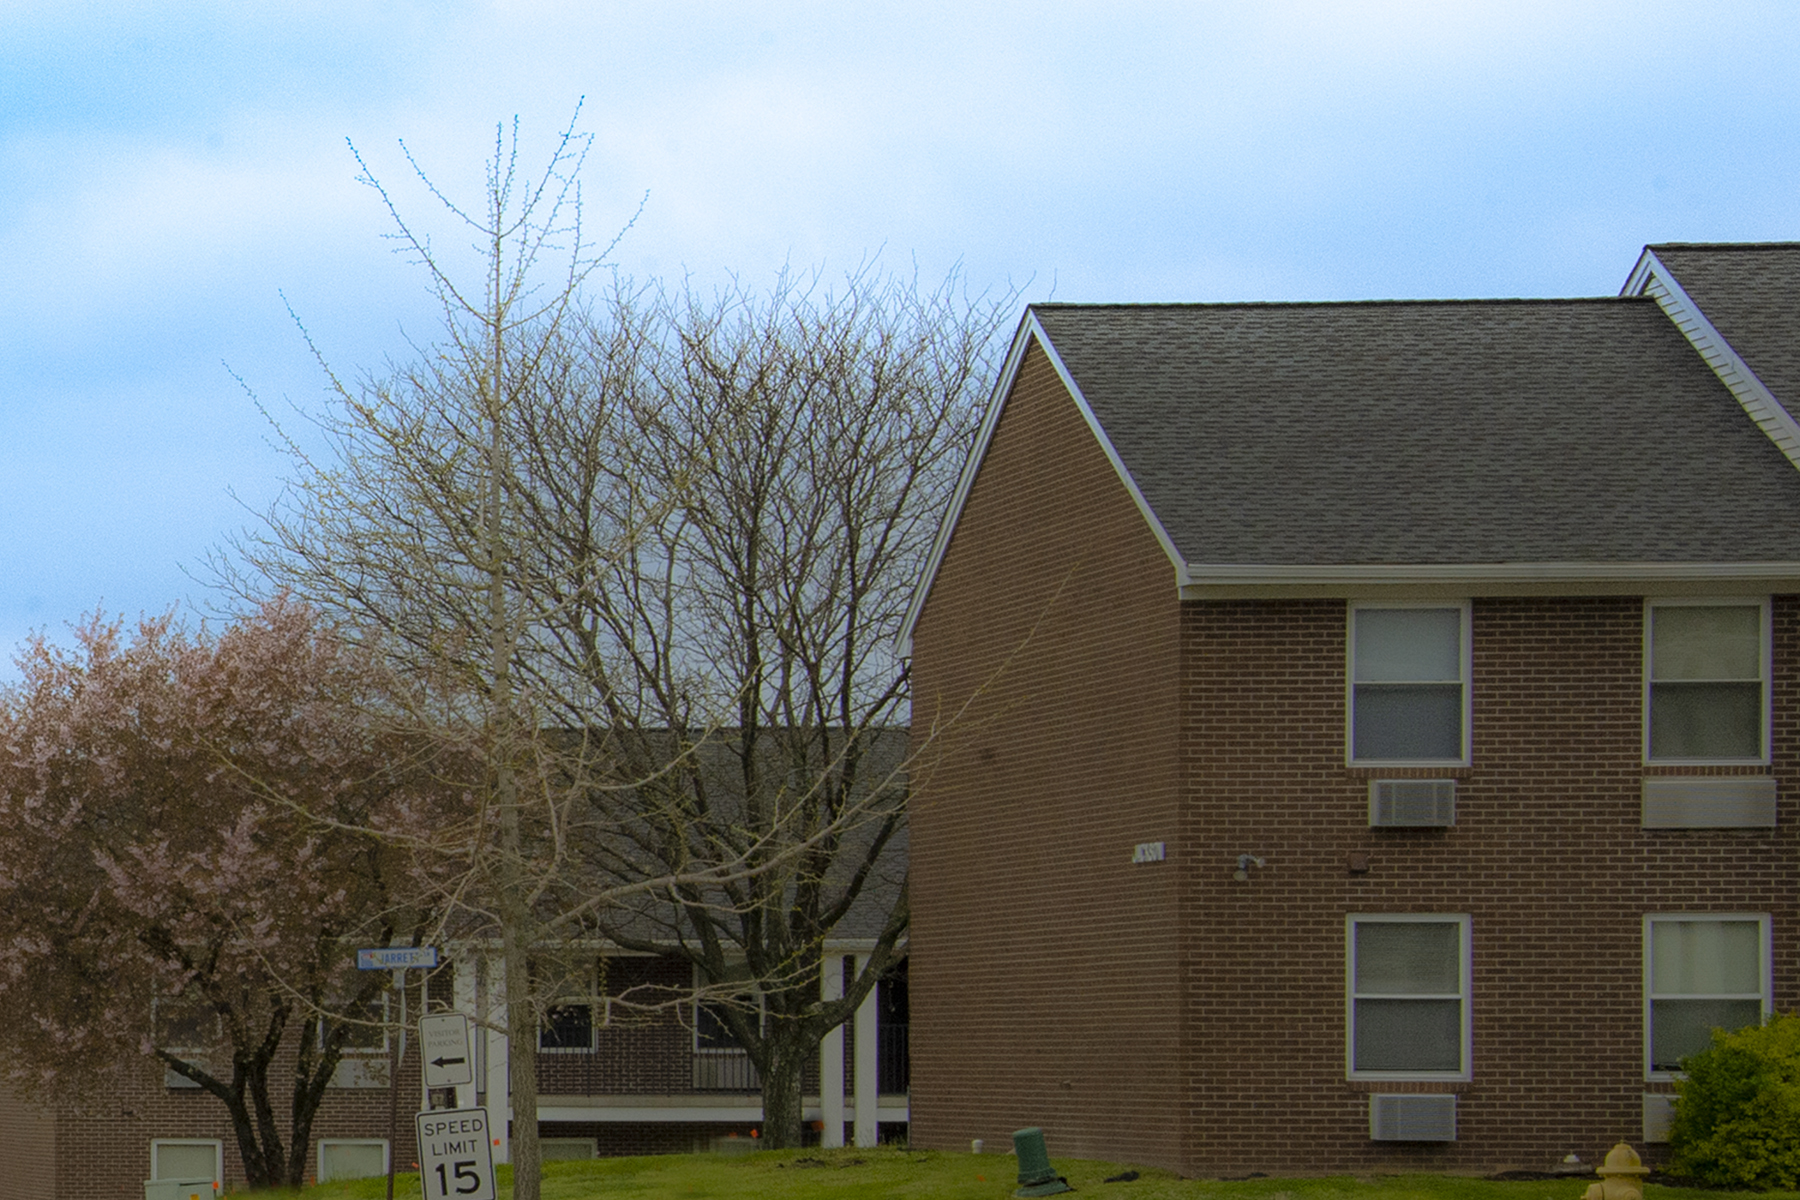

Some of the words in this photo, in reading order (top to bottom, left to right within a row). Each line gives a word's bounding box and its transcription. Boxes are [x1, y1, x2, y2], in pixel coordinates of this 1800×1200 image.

[428, 1028, 461, 1038] VISITOR
[427, 1038, 464, 1048] PARKING
[424, 1118, 484, 1137] SPEED
[431, 1139, 478, 1156] LIMIT
[435, 1160, 481, 1196] 15
